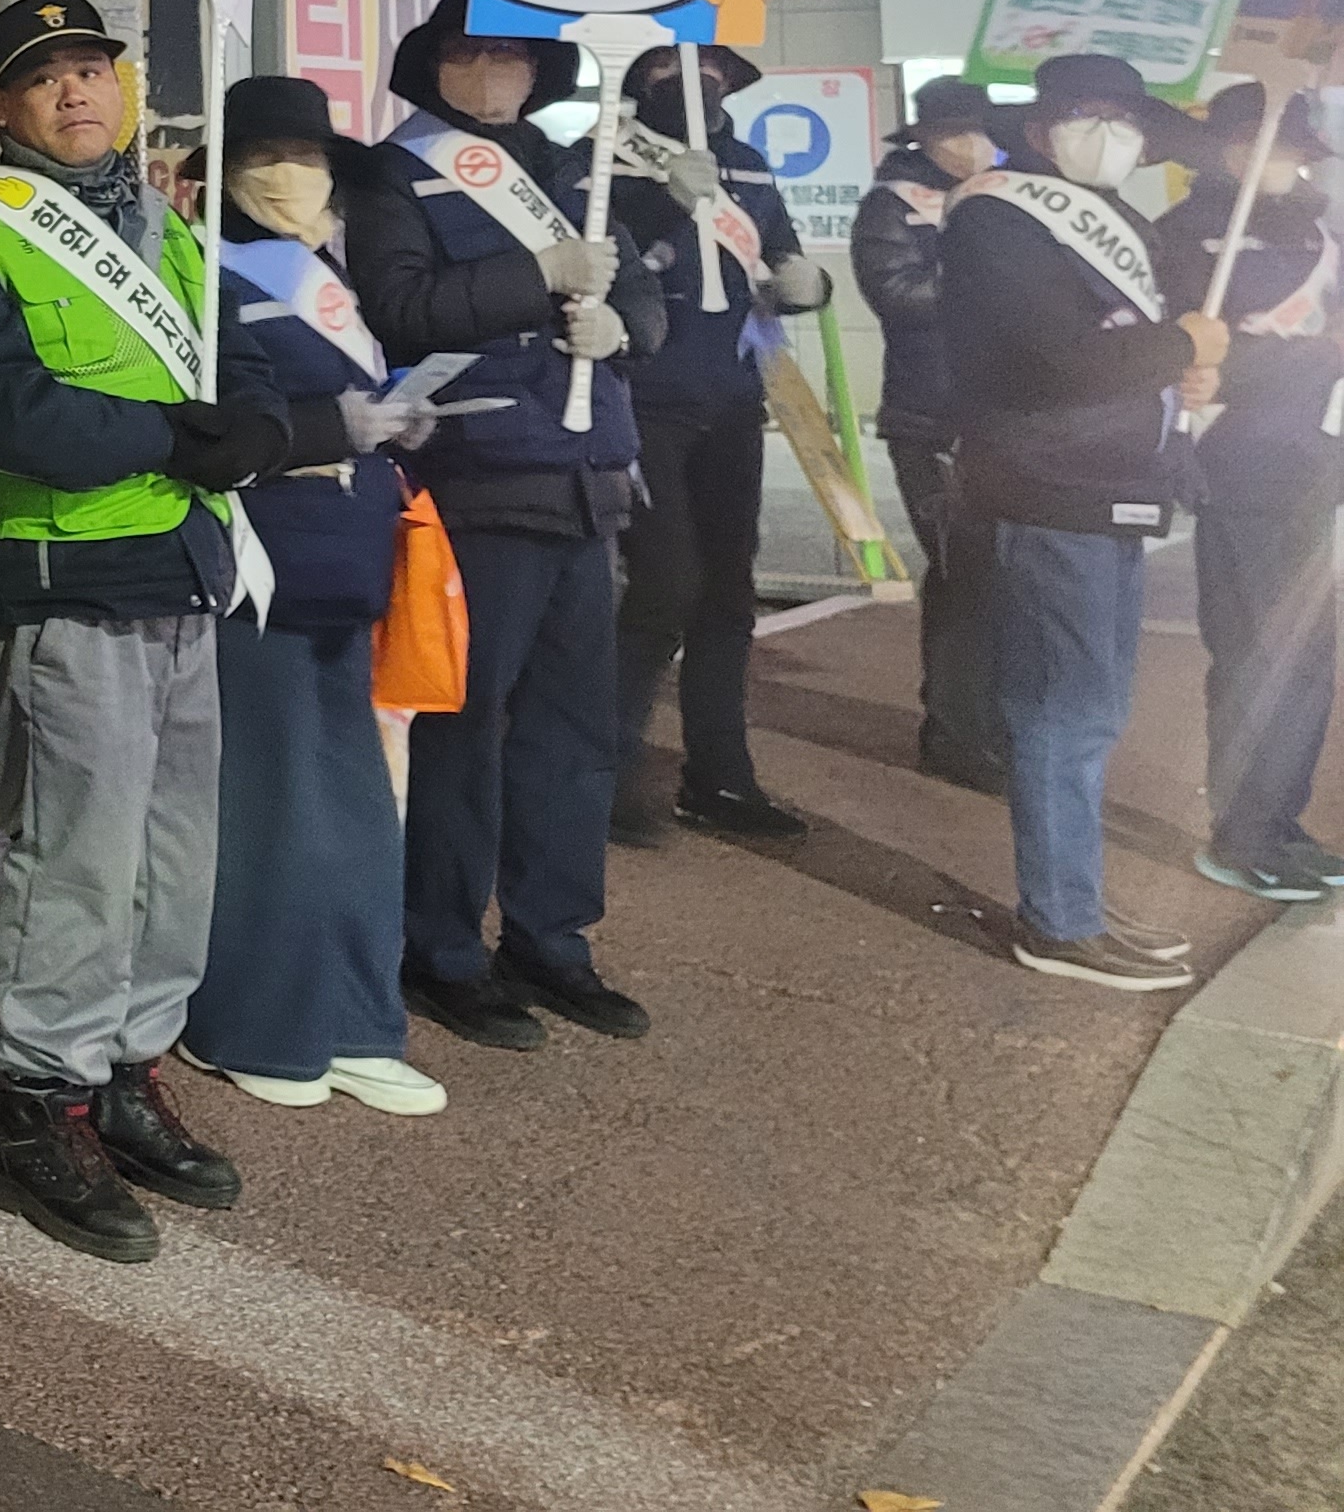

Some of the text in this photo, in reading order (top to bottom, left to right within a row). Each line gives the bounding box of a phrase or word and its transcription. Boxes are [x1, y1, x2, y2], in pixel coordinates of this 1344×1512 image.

[1016, 180, 1072, 213] NO
[30, 199, 100, 259] 학원
[95, 251, 132, 291] 앞
[127, 282, 203, 385] 전자담
